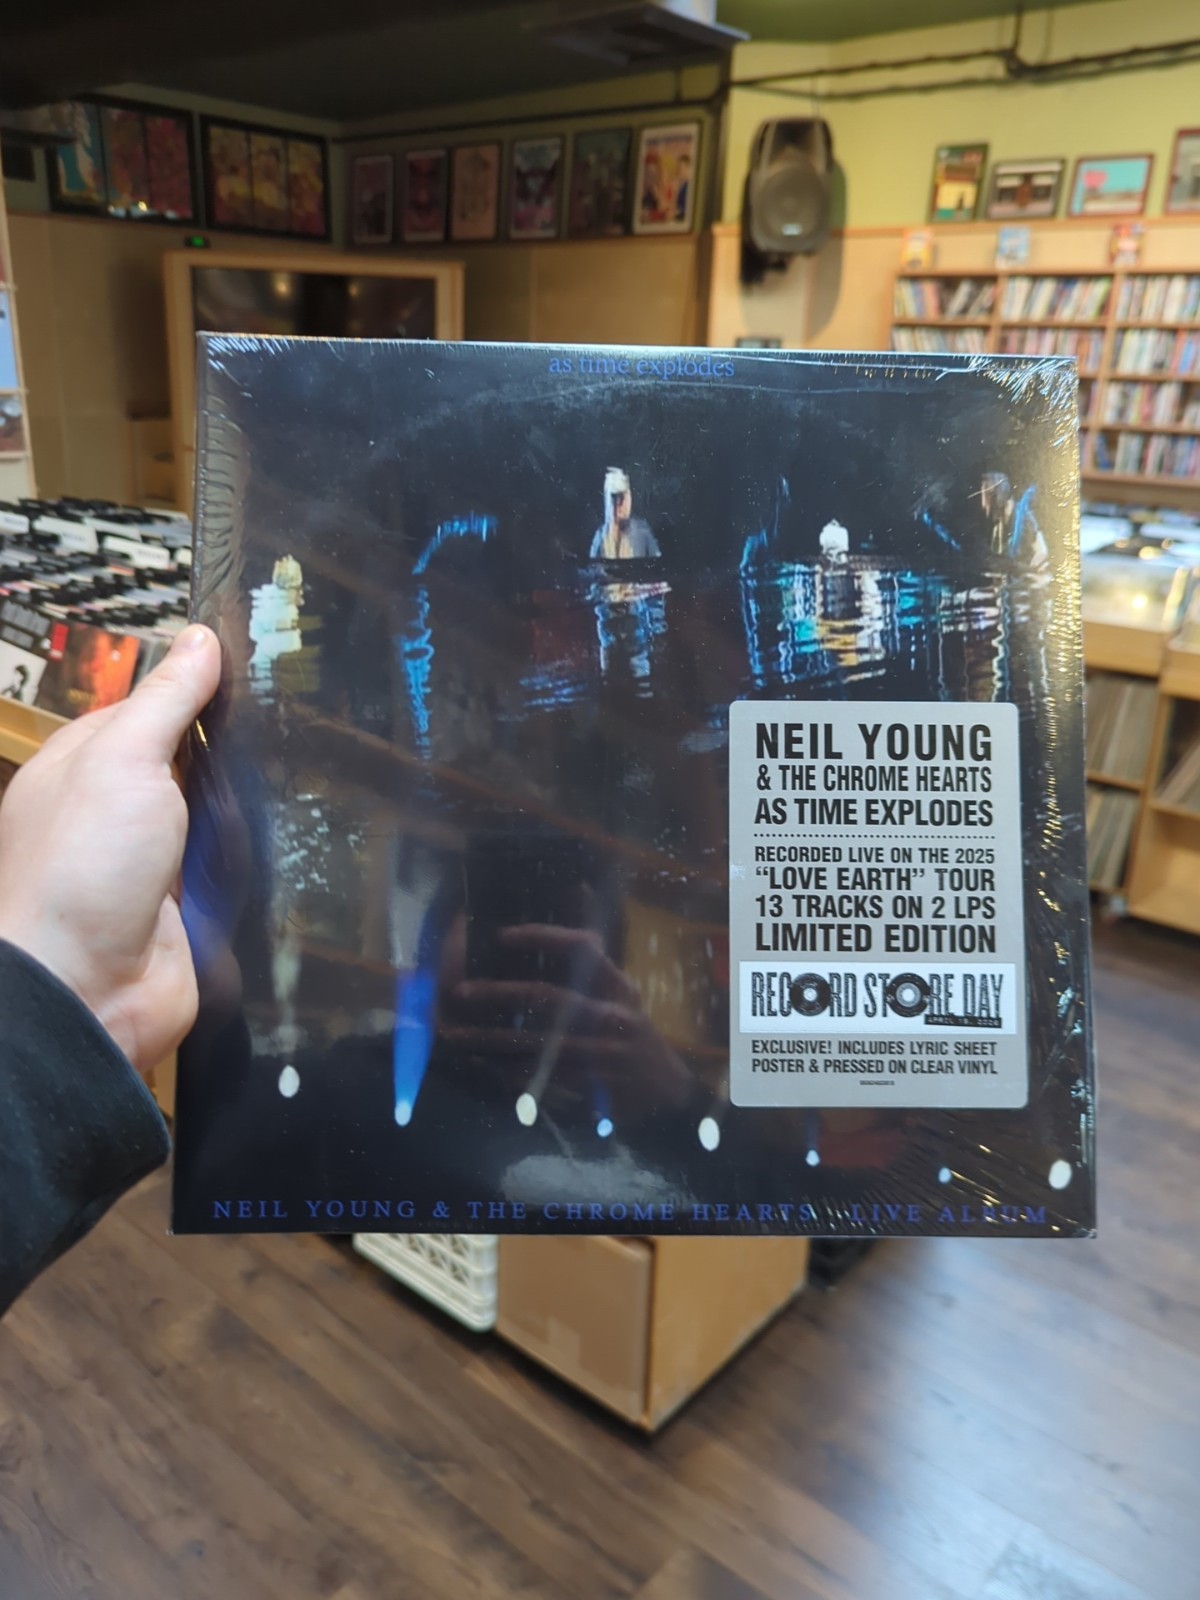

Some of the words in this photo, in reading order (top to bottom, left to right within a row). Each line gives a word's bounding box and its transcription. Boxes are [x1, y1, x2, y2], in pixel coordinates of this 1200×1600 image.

[549, 357, 572, 373] as
[579, 357, 630, 375] time
[636, 355, 735, 380] explodes
[756, 723, 843, 759] NEIL
[858, 724, 992, 761] YOUNG
[756, 764, 771, 790] &
[778, 765, 816, 791] THE
[824, 766, 908, 792] CHROME
[916, 766, 992, 792] HEARTS
[754, 798, 787, 824] AS
[794, 798, 858, 824] TIME
[865, 800, 993, 826] EXPLODES
[755, 846, 842, 862] RECORDED
[848, 847, 884, 862] LIVE
[891, 848, 912, 863] ON
[918, 848, 949, 863] THE
[955, 849, 995, 864] 2025
[934, 868, 995, 891] TOUR
[756, 895, 783, 917] 13
[792, 895, 883, 918] TRACKS
[892, 896, 922, 918] ON
[932, 896, 946, 918] 2
[954, 896, 995, 919] LPS
[756, 923, 872, 952] LIMITED
[884, 924, 996, 953] EDITION
[751, 972, 857, 1017] RECORD
[864, 973, 954, 1018] STORE
[963, 974, 1004, 1018] DAY
[752, 1040, 832, 1054] EXCLUSIVE!
[838, 1041, 904, 1055] INCLUDES
[910, 1042, 948, 1056] LYRIC
[954, 1042, 998, 1056] SHEET
[752, 1059, 804, 1072] POSTER
[809, 1060, 819, 1073] &
[824, 1060, 884, 1074] PRESSED
[889, 1060, 907, 1074] ON
[912, 1060, 954, 1074] CLEAR
[959, 1061, 998, 1074] VINYL
[213, 1200, 288, 1219] NEIL
[306, 1200, 416, 1218] YOUNG
[432, 1200, 449, 1219] &
[467, 1201, 527, 1220] THE
[543, 1202, 675, 1221] CHROME
[692, 1203, 812, 1222] HEARTS
[851, 1203, 921, 1223] LIVE
[937, 1205, 1046, 1224] ALBUM
